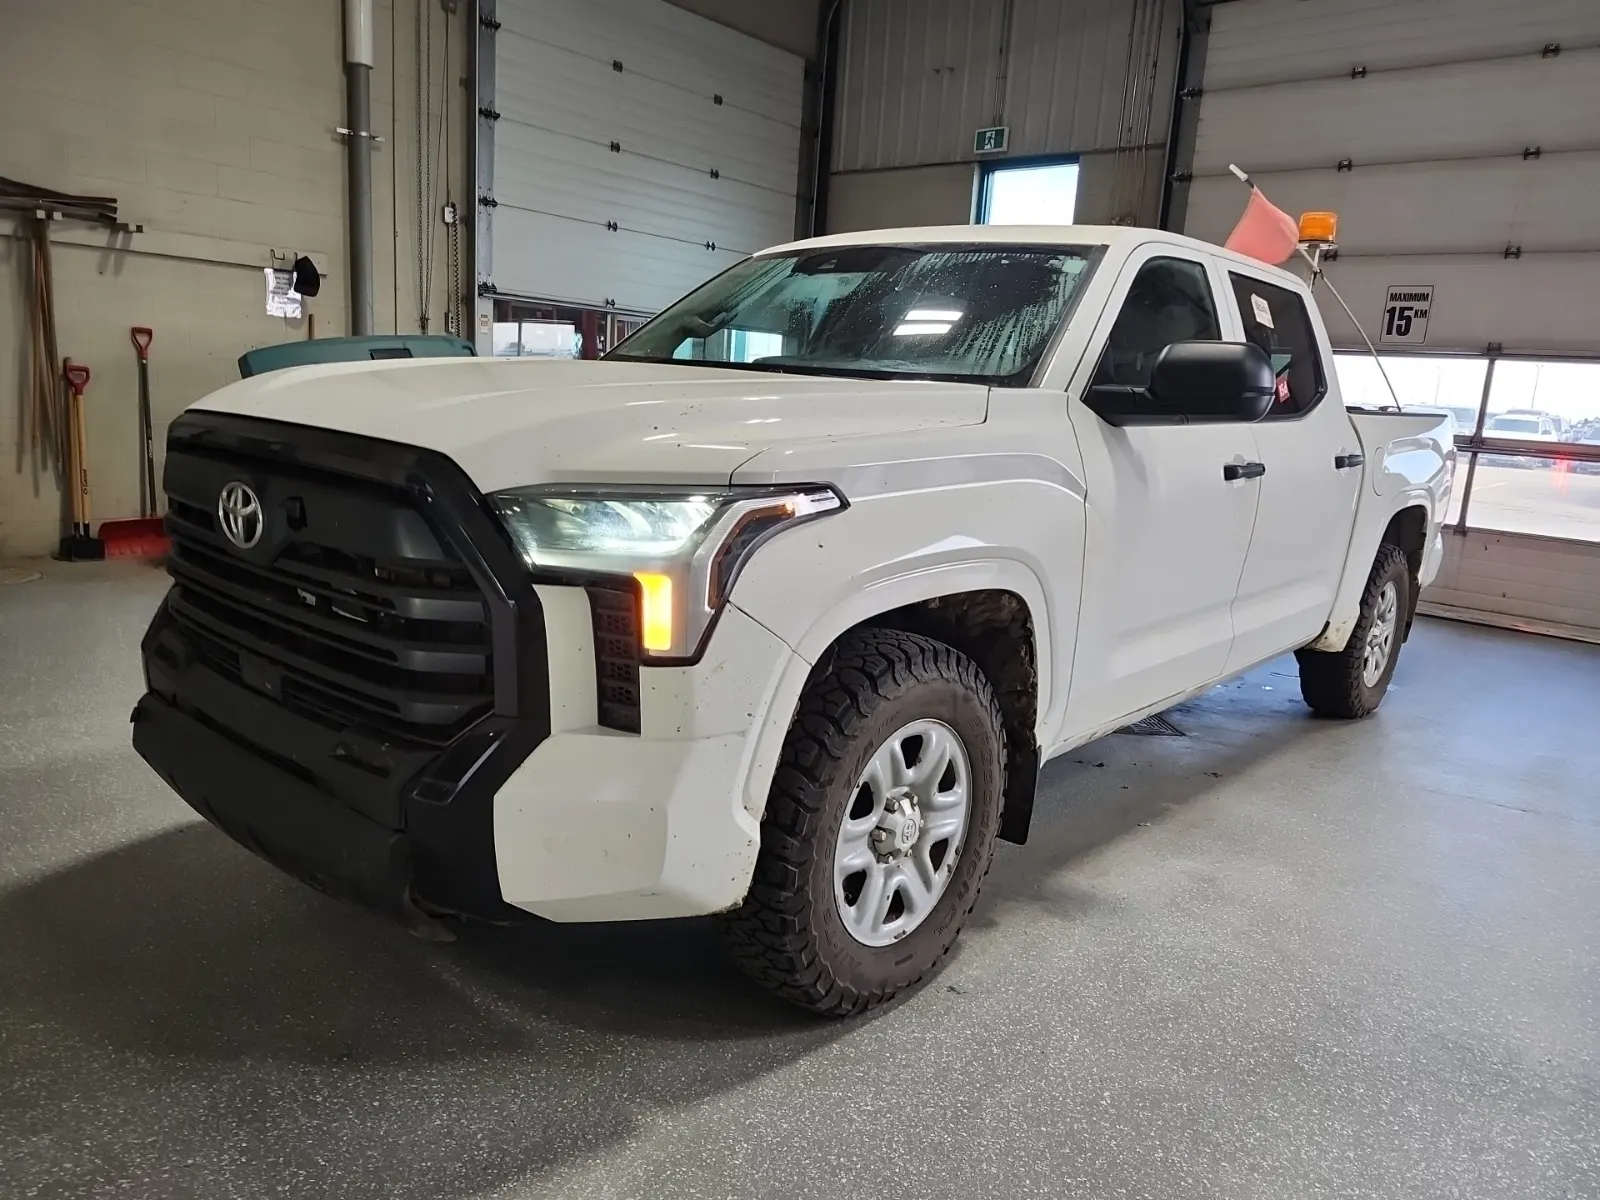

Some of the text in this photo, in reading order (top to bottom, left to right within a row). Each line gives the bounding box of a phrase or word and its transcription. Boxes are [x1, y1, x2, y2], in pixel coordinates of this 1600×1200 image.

[1389, 292, 1430, 303] MAXIMUM
[1386, 306, 1428, 337] 15 KM
[956, 715, 994, 902] BFGoodrich
